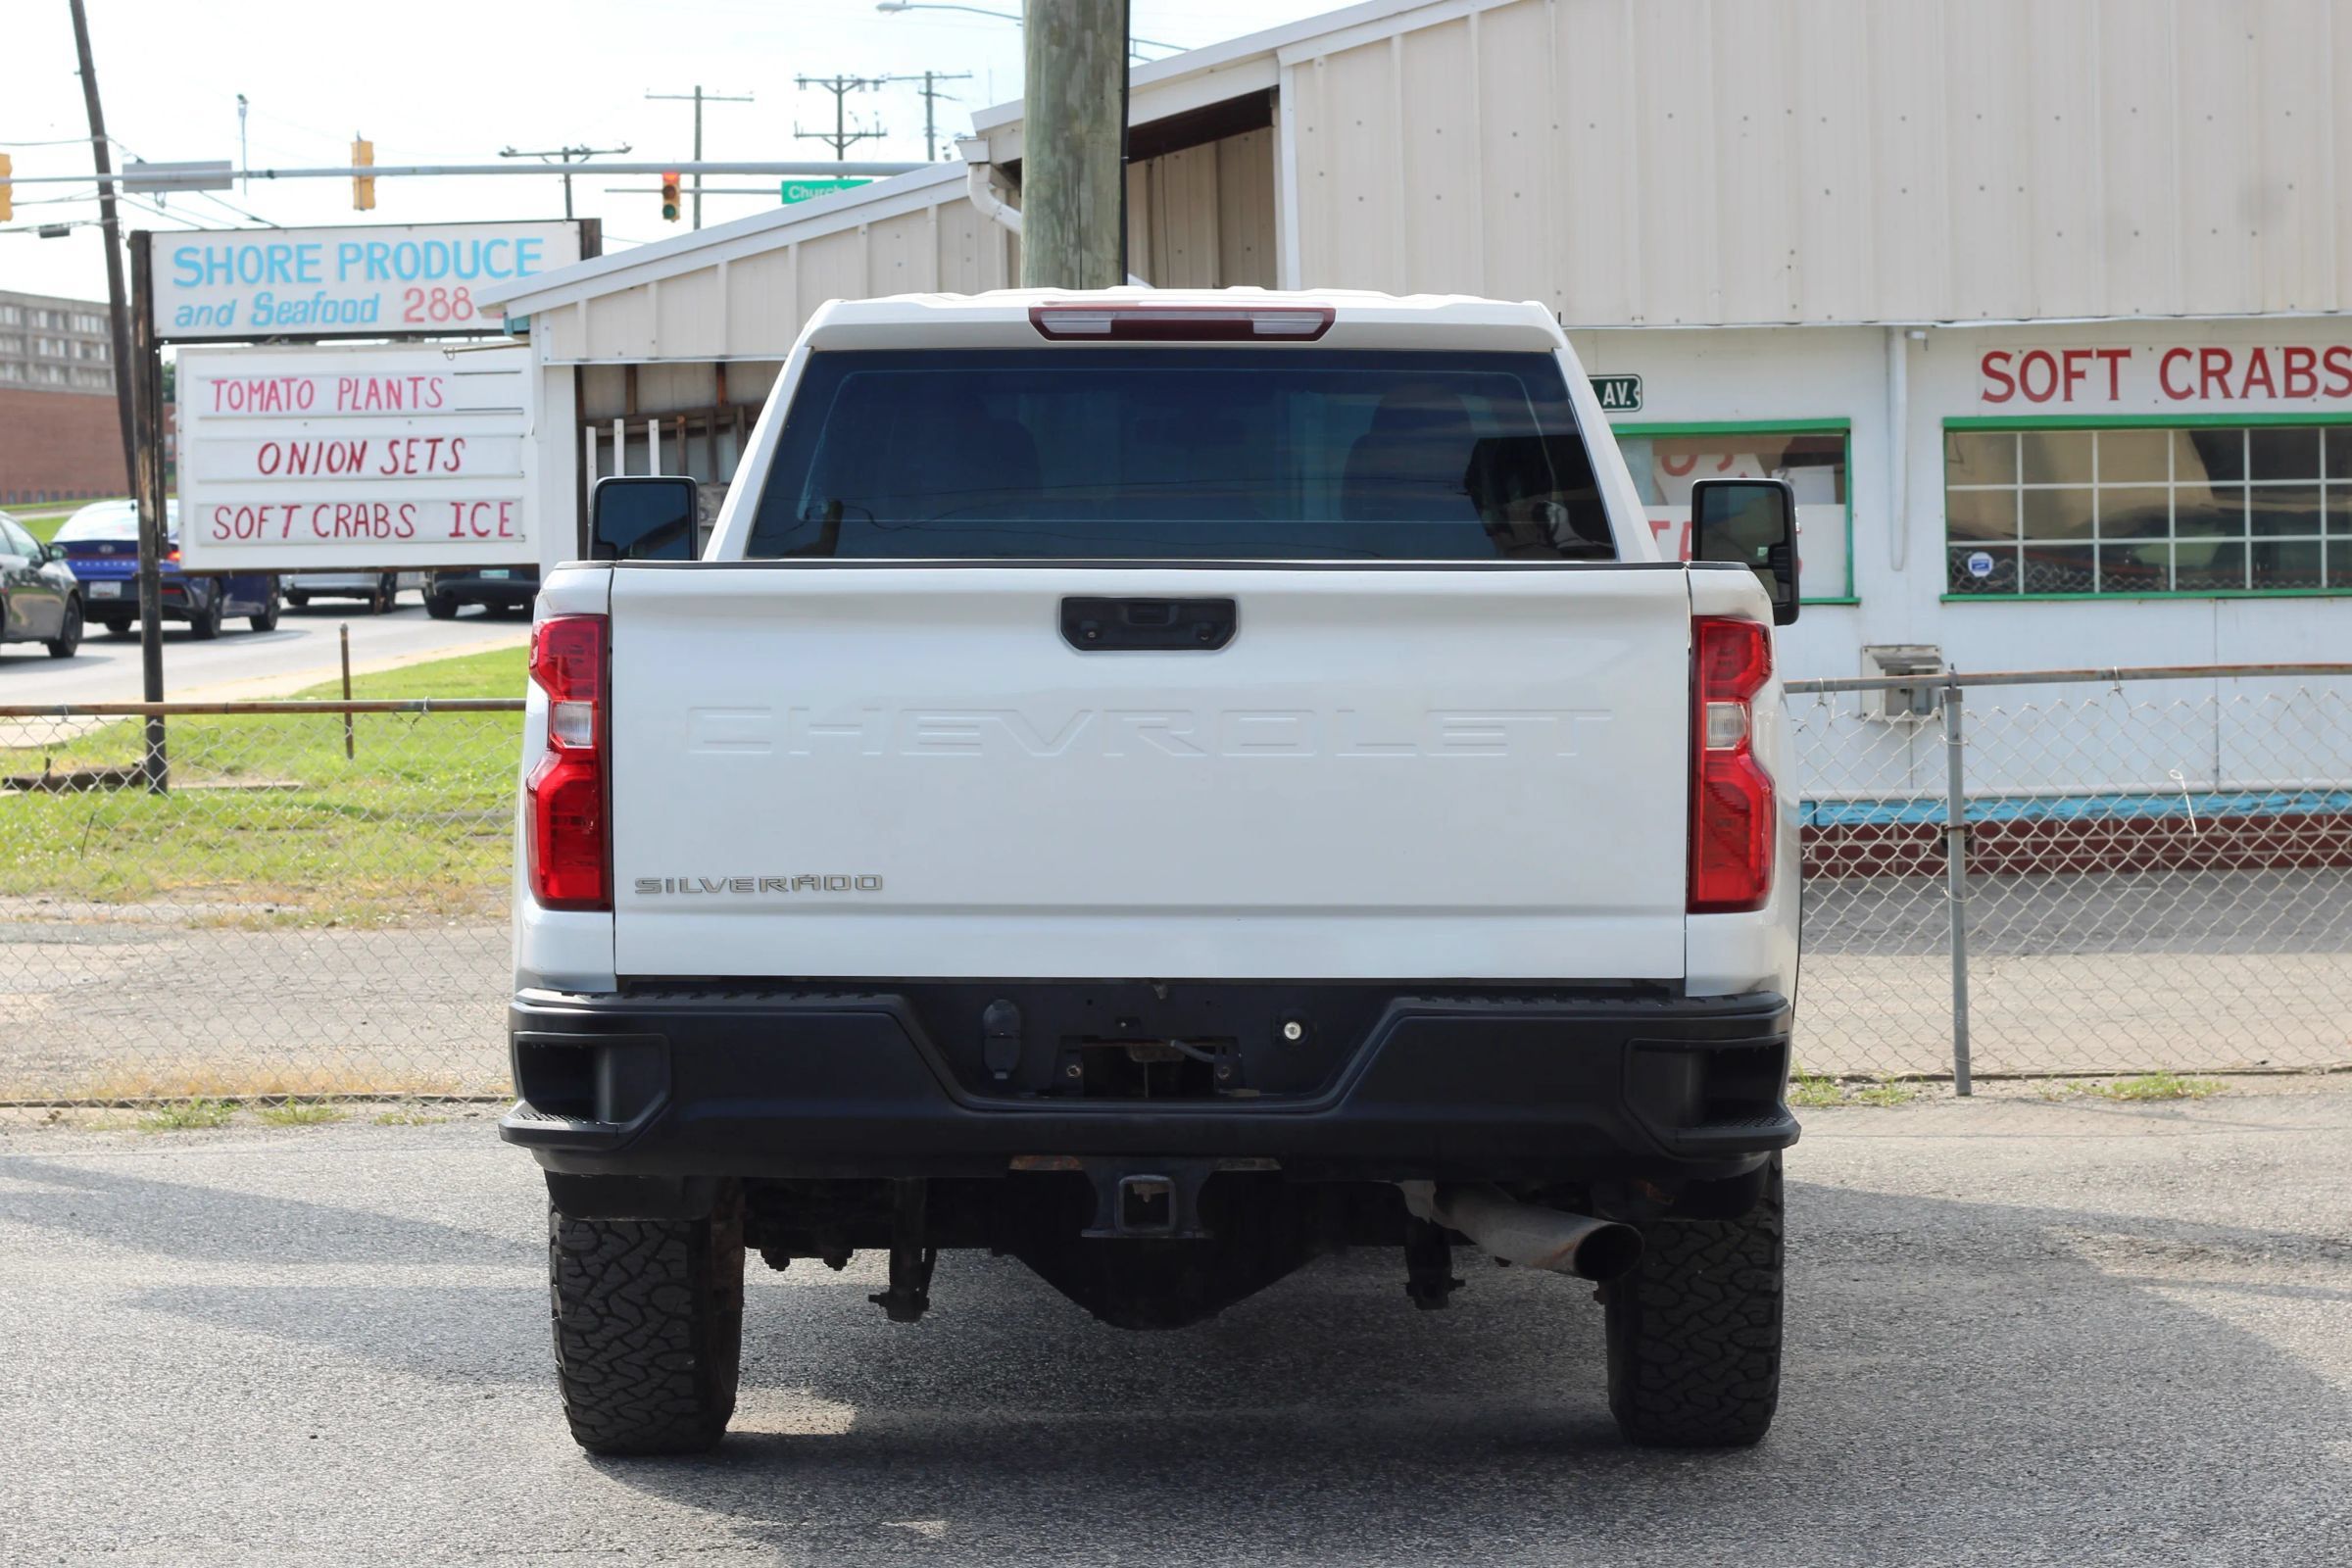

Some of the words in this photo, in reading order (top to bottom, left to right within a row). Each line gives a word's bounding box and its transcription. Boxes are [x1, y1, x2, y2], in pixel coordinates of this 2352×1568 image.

[172, 243, 322, 288] SHORE
[338, 237, 545, 282] PRODUCE
[174, 298, 238, 327] and
[250, 290, 380, 327] Seafood
[403, 285, 504, 323] 288
[210, 377, 315, 413] TOMATO
[337, 376, 444, 412] PLANTS
[1602, 381, 1632, 406] AV.
[1981, 348, 2132, 404] SOFT
[2159, 346, 2352, 401] CRABS
[257, 439, 368, 475] ONION
[379, 437, 466, 475] SETS
[212, 505, 302, 540] SOFT
[313, 503, 416, 538] CRABS
[448, 501, 514, 537] ICE
[688, 706, 1612, 758] CHEVROLET
[634, 874, 883, 894] SILVERADO
